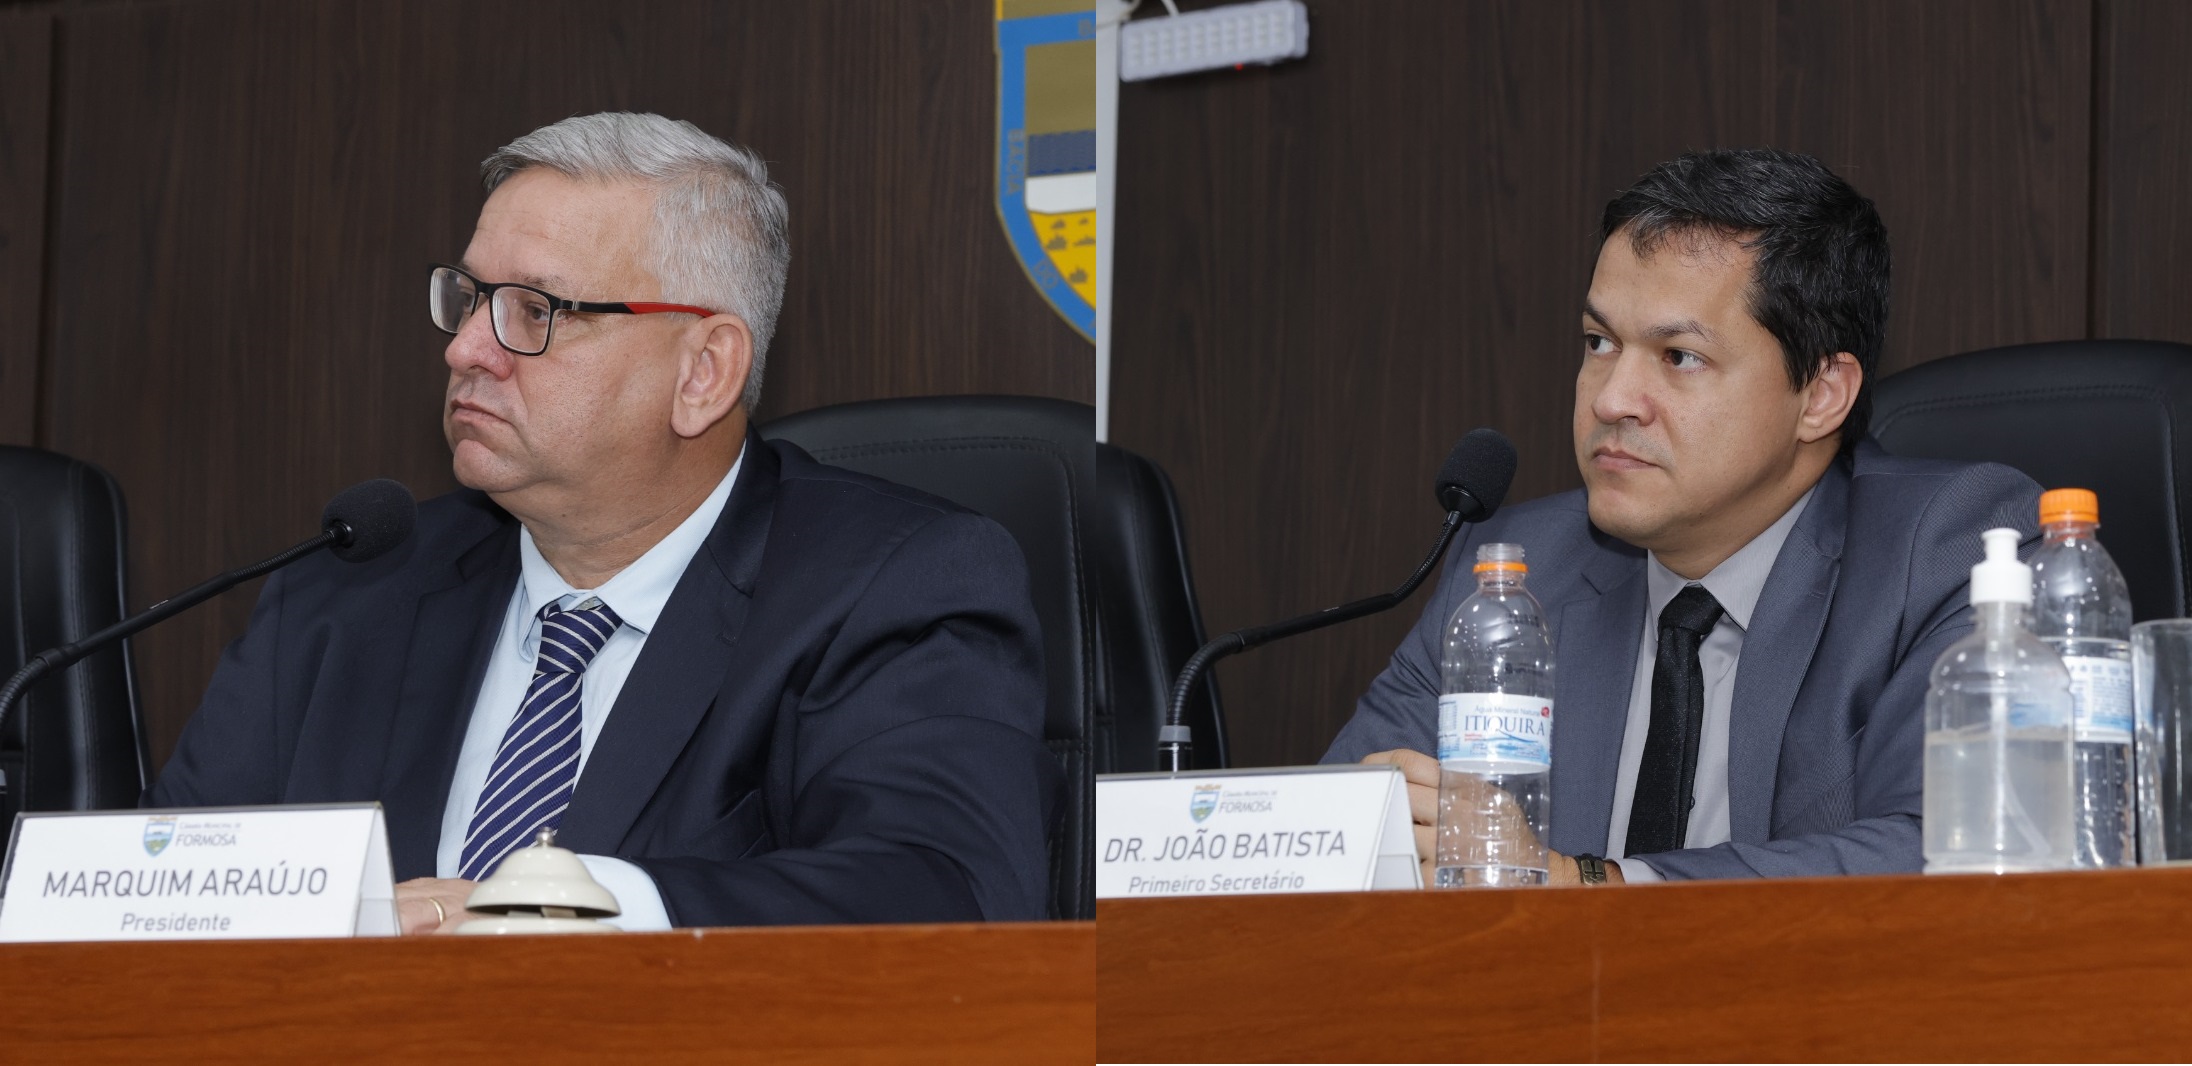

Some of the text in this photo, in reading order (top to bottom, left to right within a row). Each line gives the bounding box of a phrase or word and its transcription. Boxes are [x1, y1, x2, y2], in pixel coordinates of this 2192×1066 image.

[1464, 715, 1546, 737] ITIQUIRA
[1218, 799, 1273, 814] FORMOSA
[175, 833, 237, 847] FORMOSA
[1104, 828, 1346, 863] DR. JOÃO BATISTA
[42, 860, 328, 898] MARQUIM ARAÚJO
[1128, 869, 1304, 894] Primeiro Secretário
[120, 912, 232, 933] Presidente
